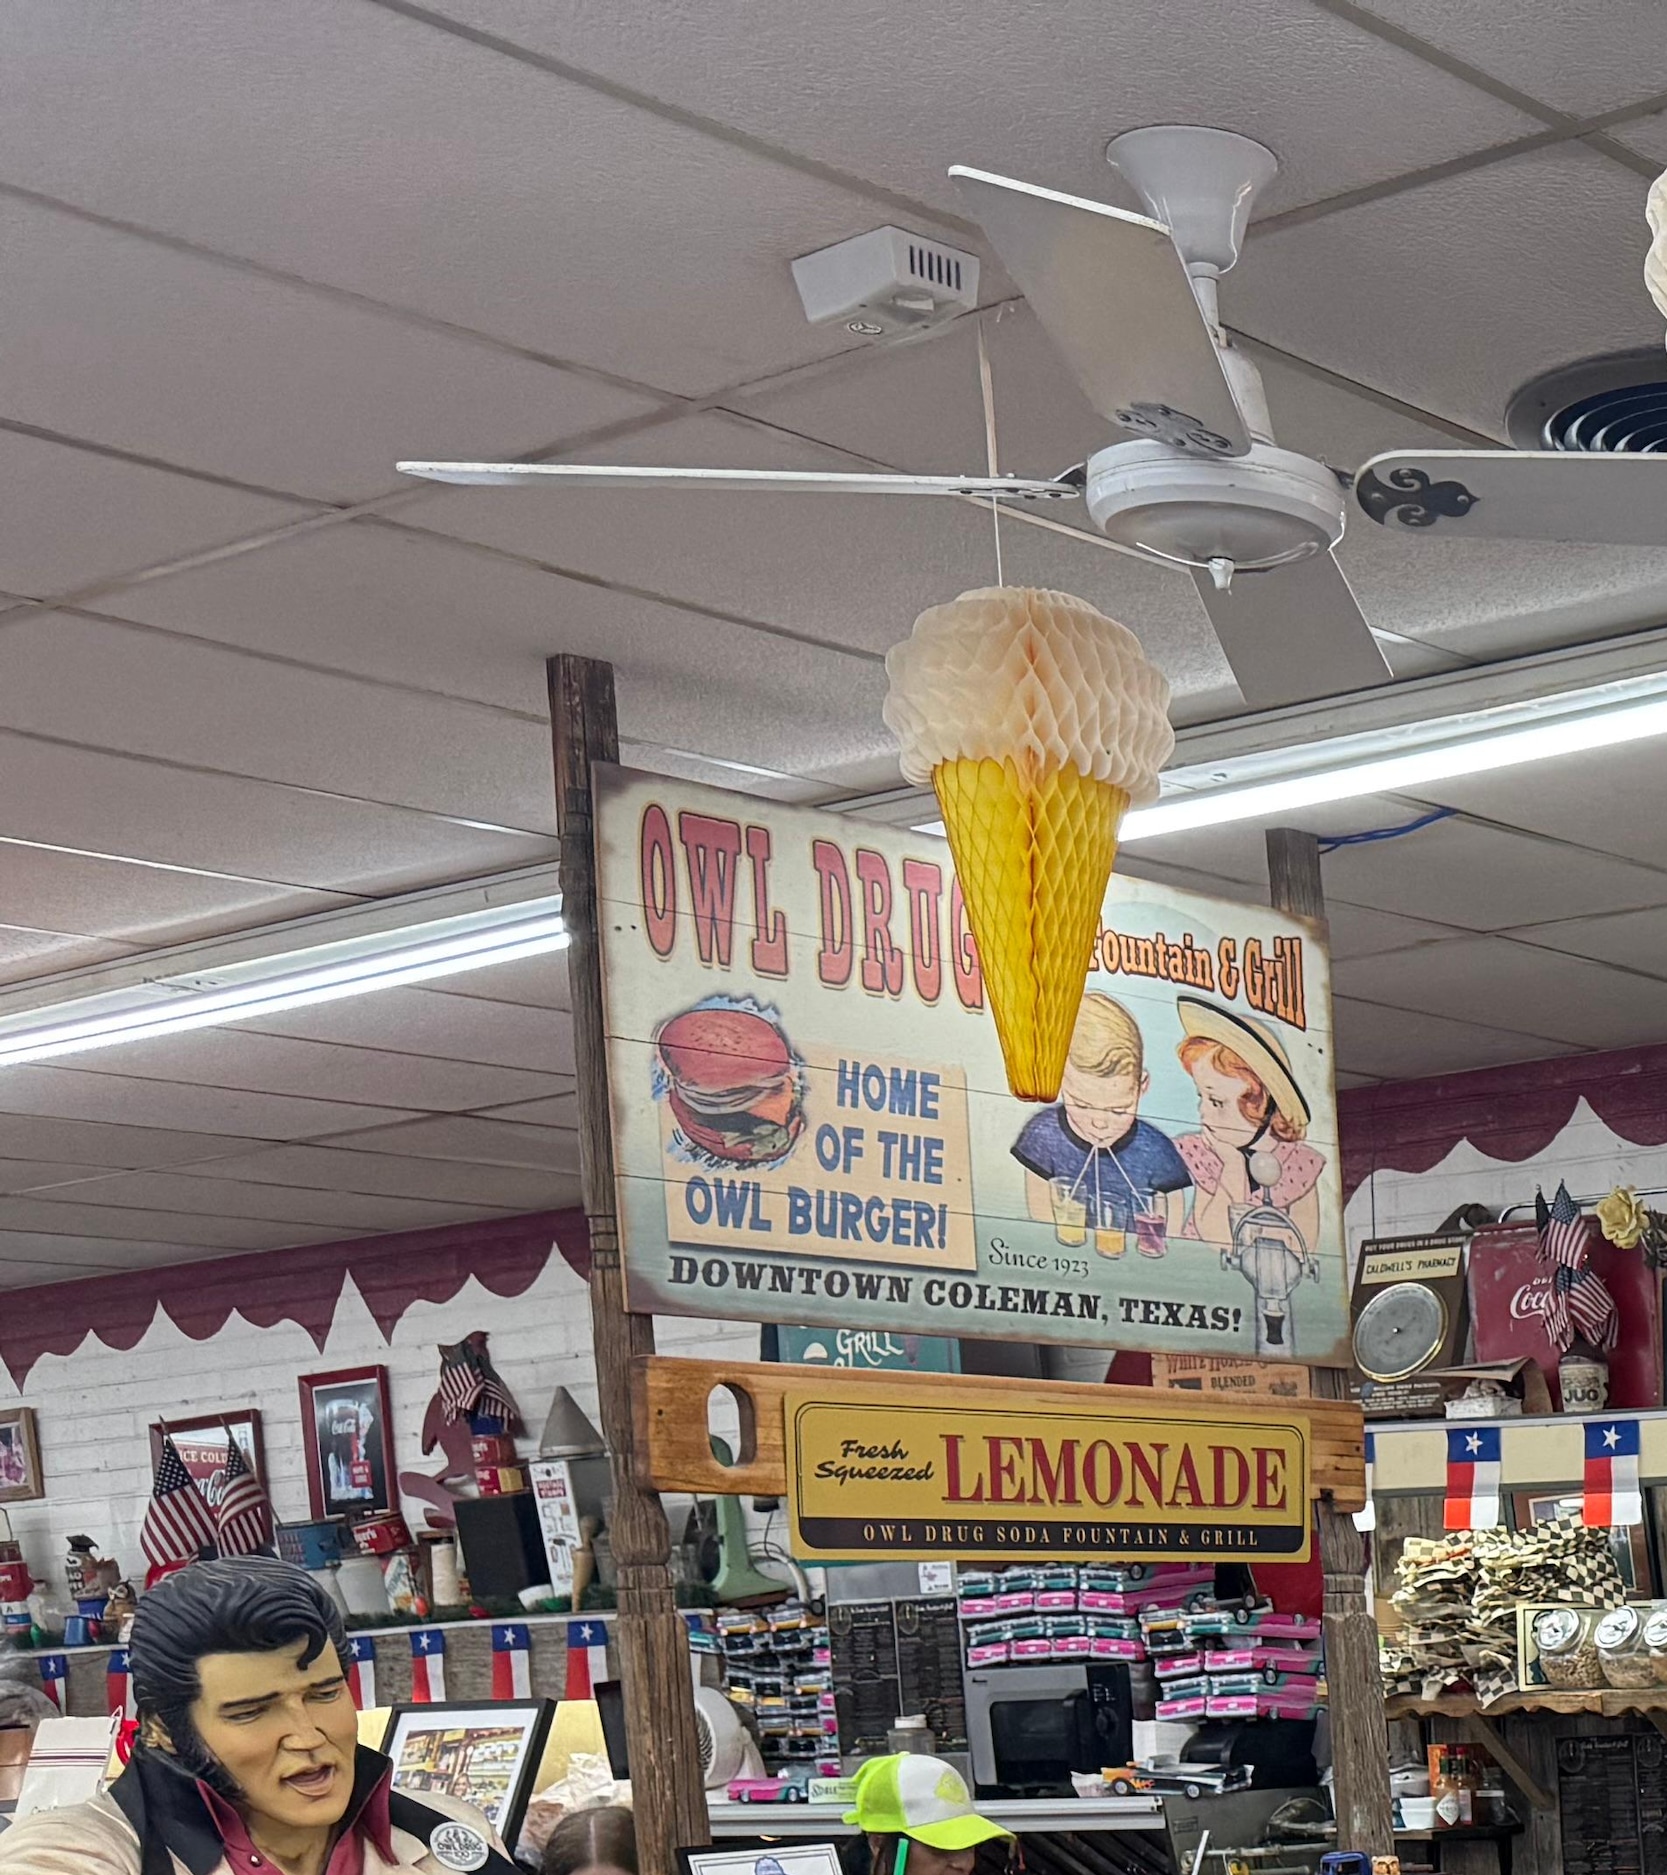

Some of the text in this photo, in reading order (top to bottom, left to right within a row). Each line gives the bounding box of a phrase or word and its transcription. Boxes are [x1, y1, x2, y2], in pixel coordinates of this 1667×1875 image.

[641, 803, 789, 976] OWL
[1217, 935, 1307, 1032] & Grill
[836, 1058, 940, 1120] HOME
[815, 1123, 944, 1185] OF THE
[685, 1175, 948, 1250] OWL BURGER!
[988, 1237, 1091, 1278] Since 1923
[667, 1255, 1243, 1333] DOWNTOWN COLEMAN, TEXAS!
[836, 1328, 905, 1367] GRILL
[1563, 1388, 1599, 1403] JUG
[814, 1459, 934, 1486] Squeezed
[841, 1433, 1289, 1512] Fresh LEMONADE
[863, 1524, 1259, 1548] OWL DRUG SODA FOUNTAIN & GRILL
